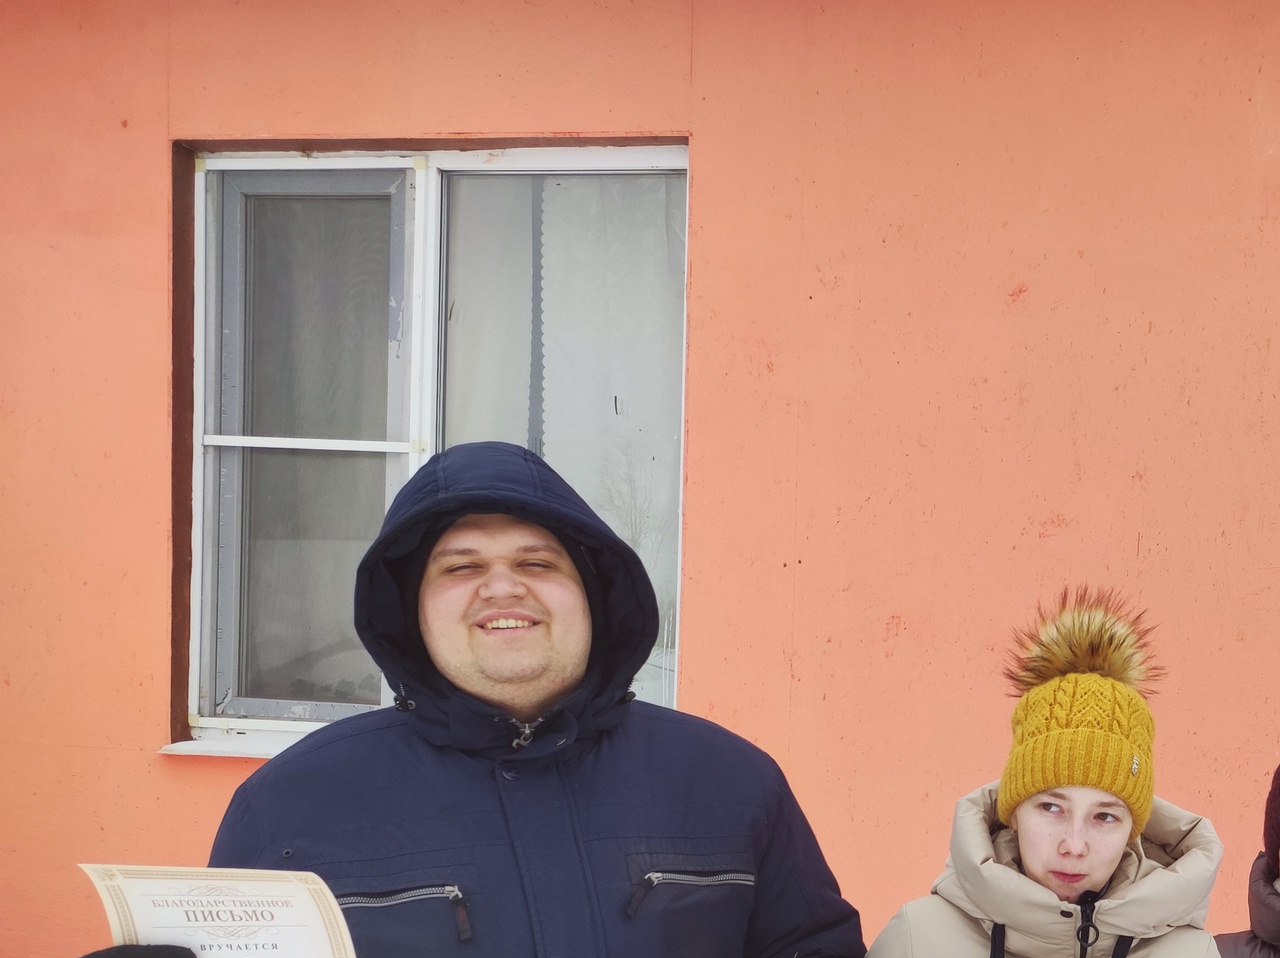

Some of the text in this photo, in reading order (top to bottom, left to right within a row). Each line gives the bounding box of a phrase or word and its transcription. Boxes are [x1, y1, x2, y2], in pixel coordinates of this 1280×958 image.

[151, 899, 294, 909] БЛАГОДАРСТВЕННОЕ
[183, 909, 275, 923] ПИСЬМО
[199, 942, 279, 952] ВРУЧАЕТСЯ
